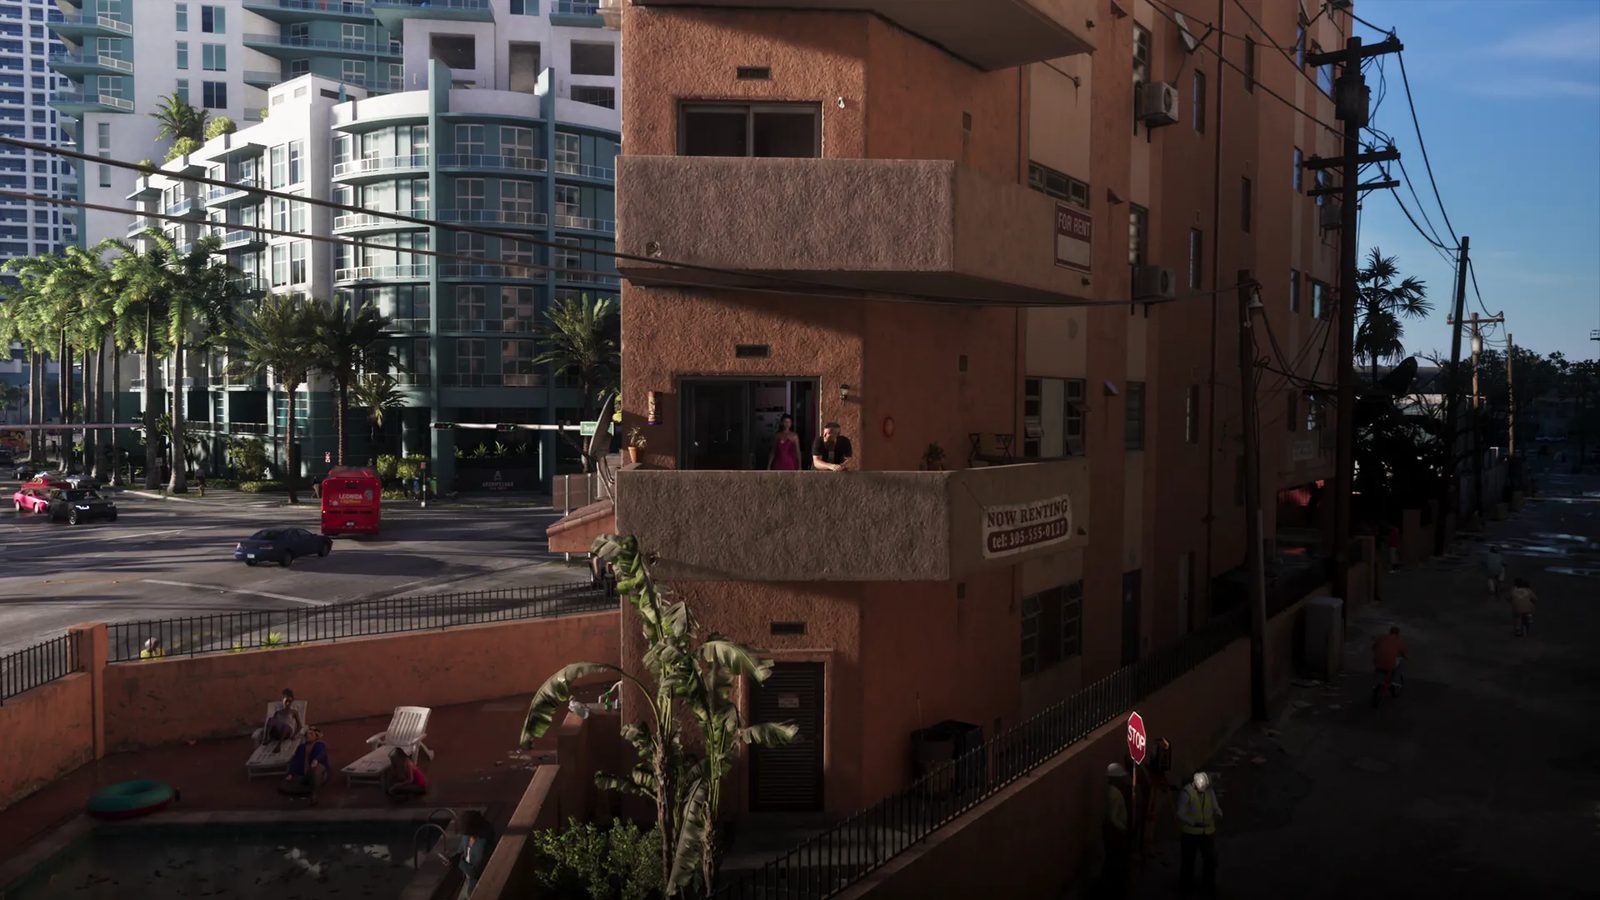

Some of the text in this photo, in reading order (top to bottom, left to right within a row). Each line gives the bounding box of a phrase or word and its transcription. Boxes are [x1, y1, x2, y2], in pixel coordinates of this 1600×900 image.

[1058, 211, 1090, 238] FOR RENT
[987, 499, 1068, 528] NOW RENTING
[992, 533, 1008, 549] tel:
[1127, 724, 1146, 751] STOP
